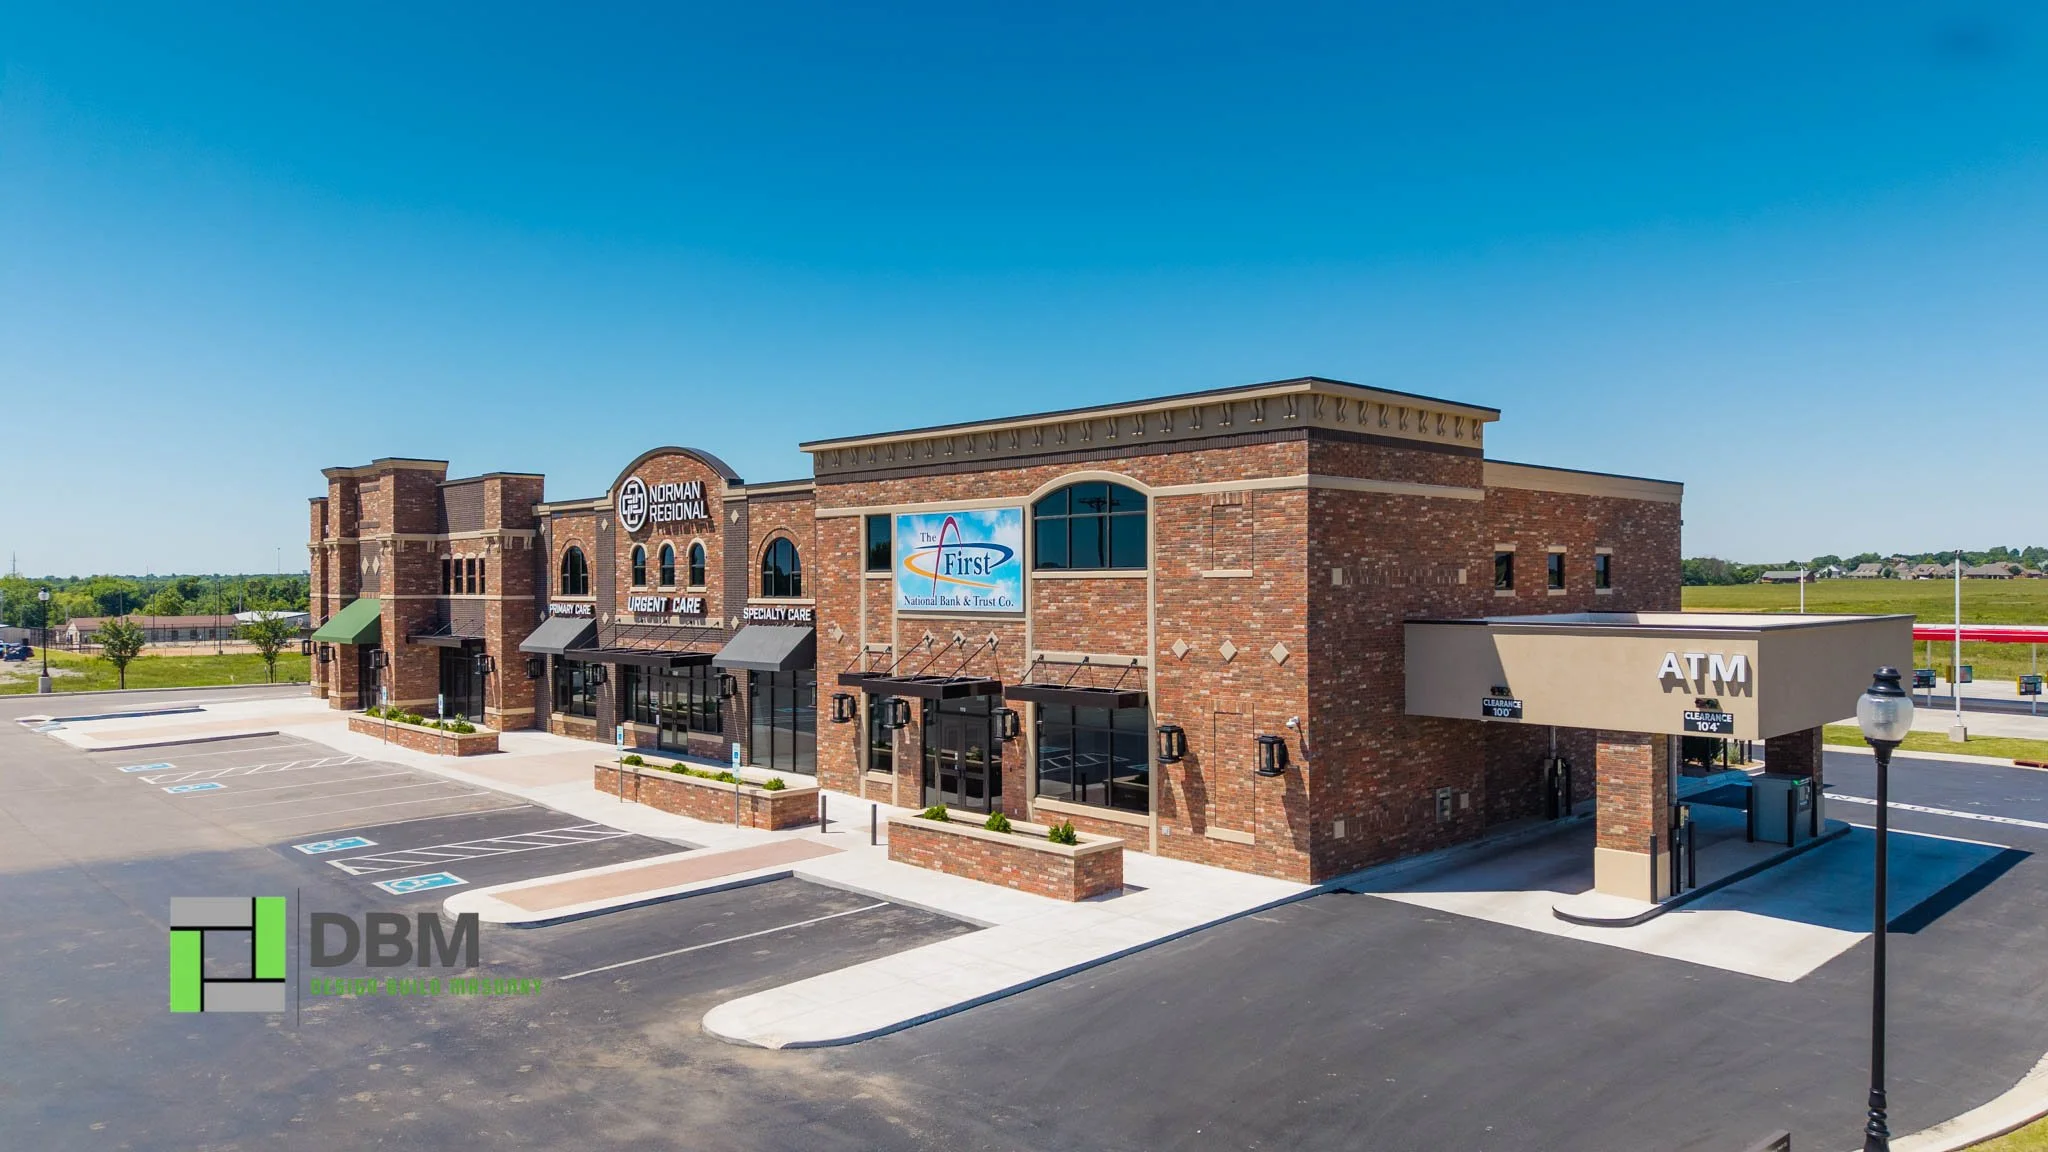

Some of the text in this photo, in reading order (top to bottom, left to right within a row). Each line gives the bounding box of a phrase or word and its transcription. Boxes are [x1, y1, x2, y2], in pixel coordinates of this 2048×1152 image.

[649, 480, 701, 503] NORMAN
[649, 501, 708, 523] REGIONAL
[920, 532, 937, 543] The
[944, 550, 991, 575] First
[627, 596, 702, 614] URGENT CARE
[904, 595, 1014, 607] National Bank & Trust Co.
[549, 603, 591, 615] PRIMARY CARE
[743, 607, 812, 622] SPECIALTY CARE
[1657, 651, 1746, 683] ATM
[1483, 699, 1522, 709] CLEARANCE
[1684, 711, 1733, 723] CLEARANCE
